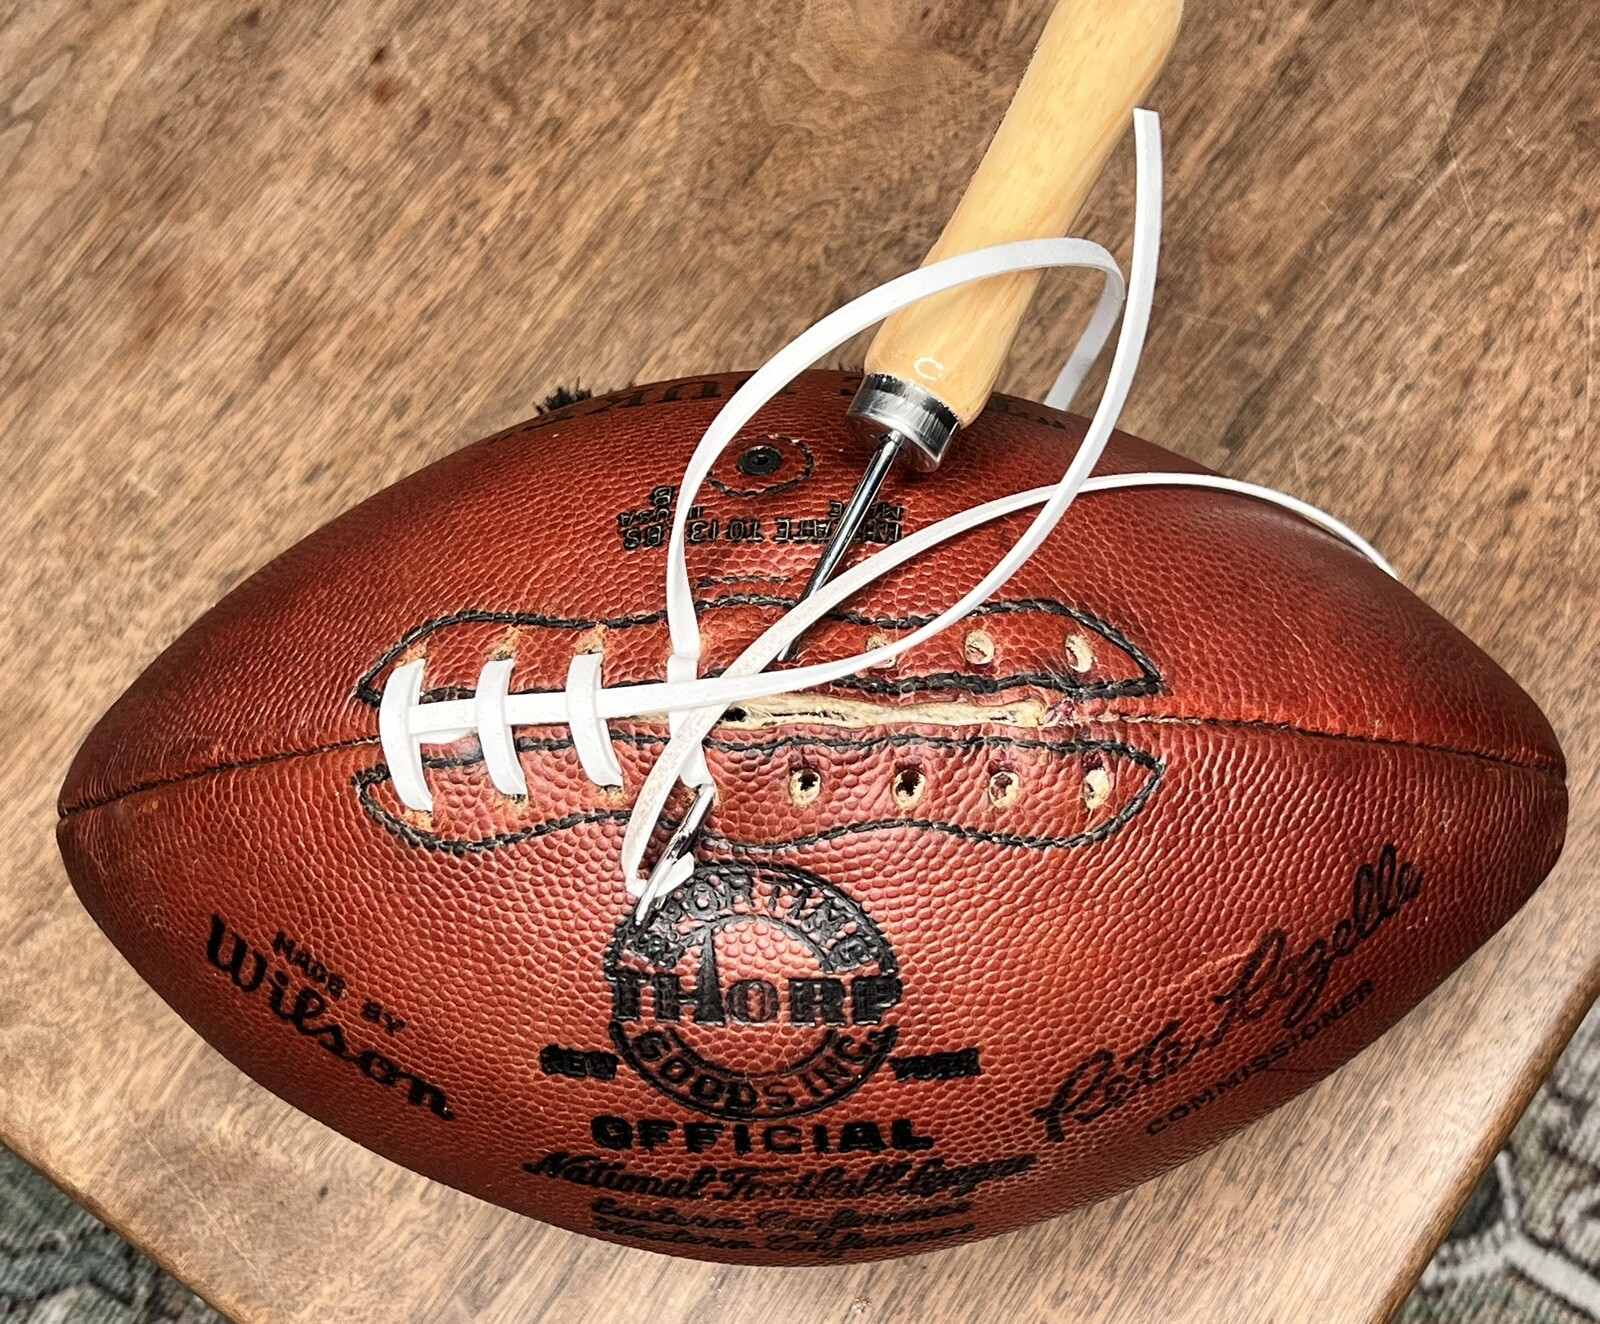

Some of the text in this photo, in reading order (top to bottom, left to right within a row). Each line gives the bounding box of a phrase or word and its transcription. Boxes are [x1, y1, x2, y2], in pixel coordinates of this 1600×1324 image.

[728, 517, 765, 543] TO
[206, 913, 456, 1122] Wilson
[605, 965, 903, 1027] THORP
[631, 1029, 796, 1109] GOODS
[1145, 979, 1377, 1136] COMMISSIONER
[590, 1114, 935, 1155] OFFICIAL
[522, 1151, 718, 1200] National
